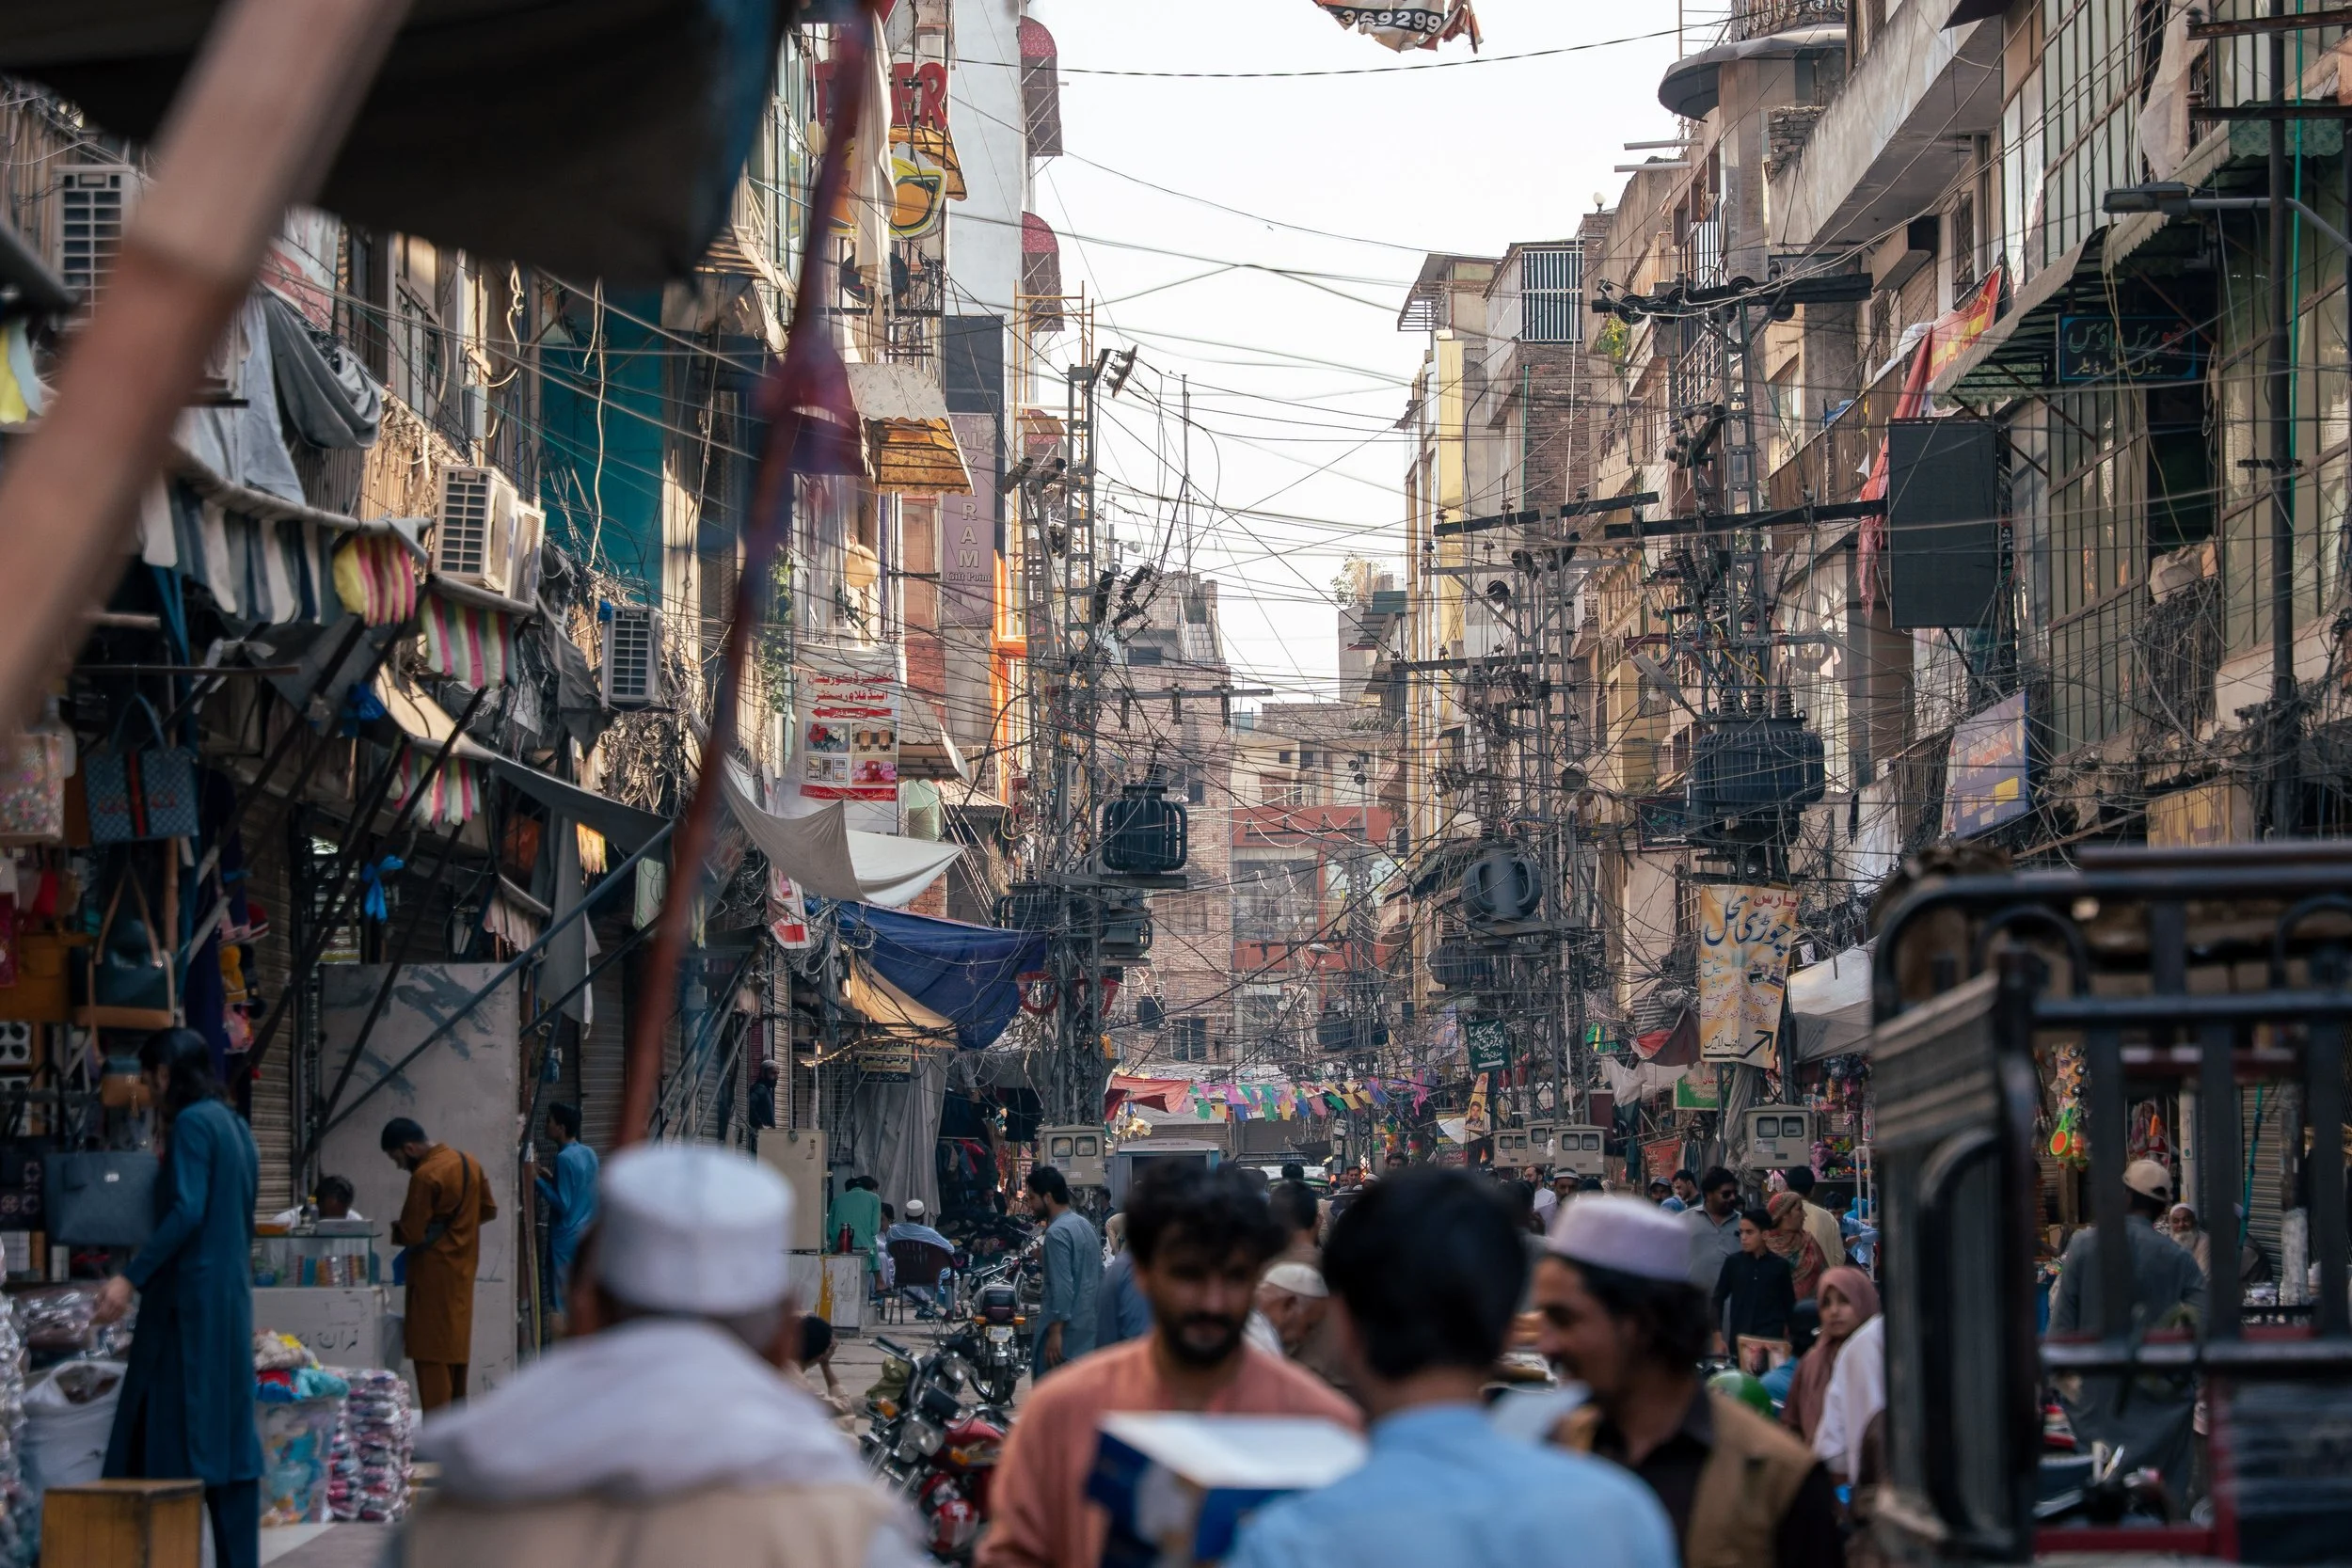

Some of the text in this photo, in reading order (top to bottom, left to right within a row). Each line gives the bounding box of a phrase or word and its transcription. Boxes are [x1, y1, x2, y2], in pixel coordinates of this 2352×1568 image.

[956, 431, 985, 451] AL
[946, 571, 993, 582] Gift Point
[1704, 895, 1792, 958] چوڑی محل
